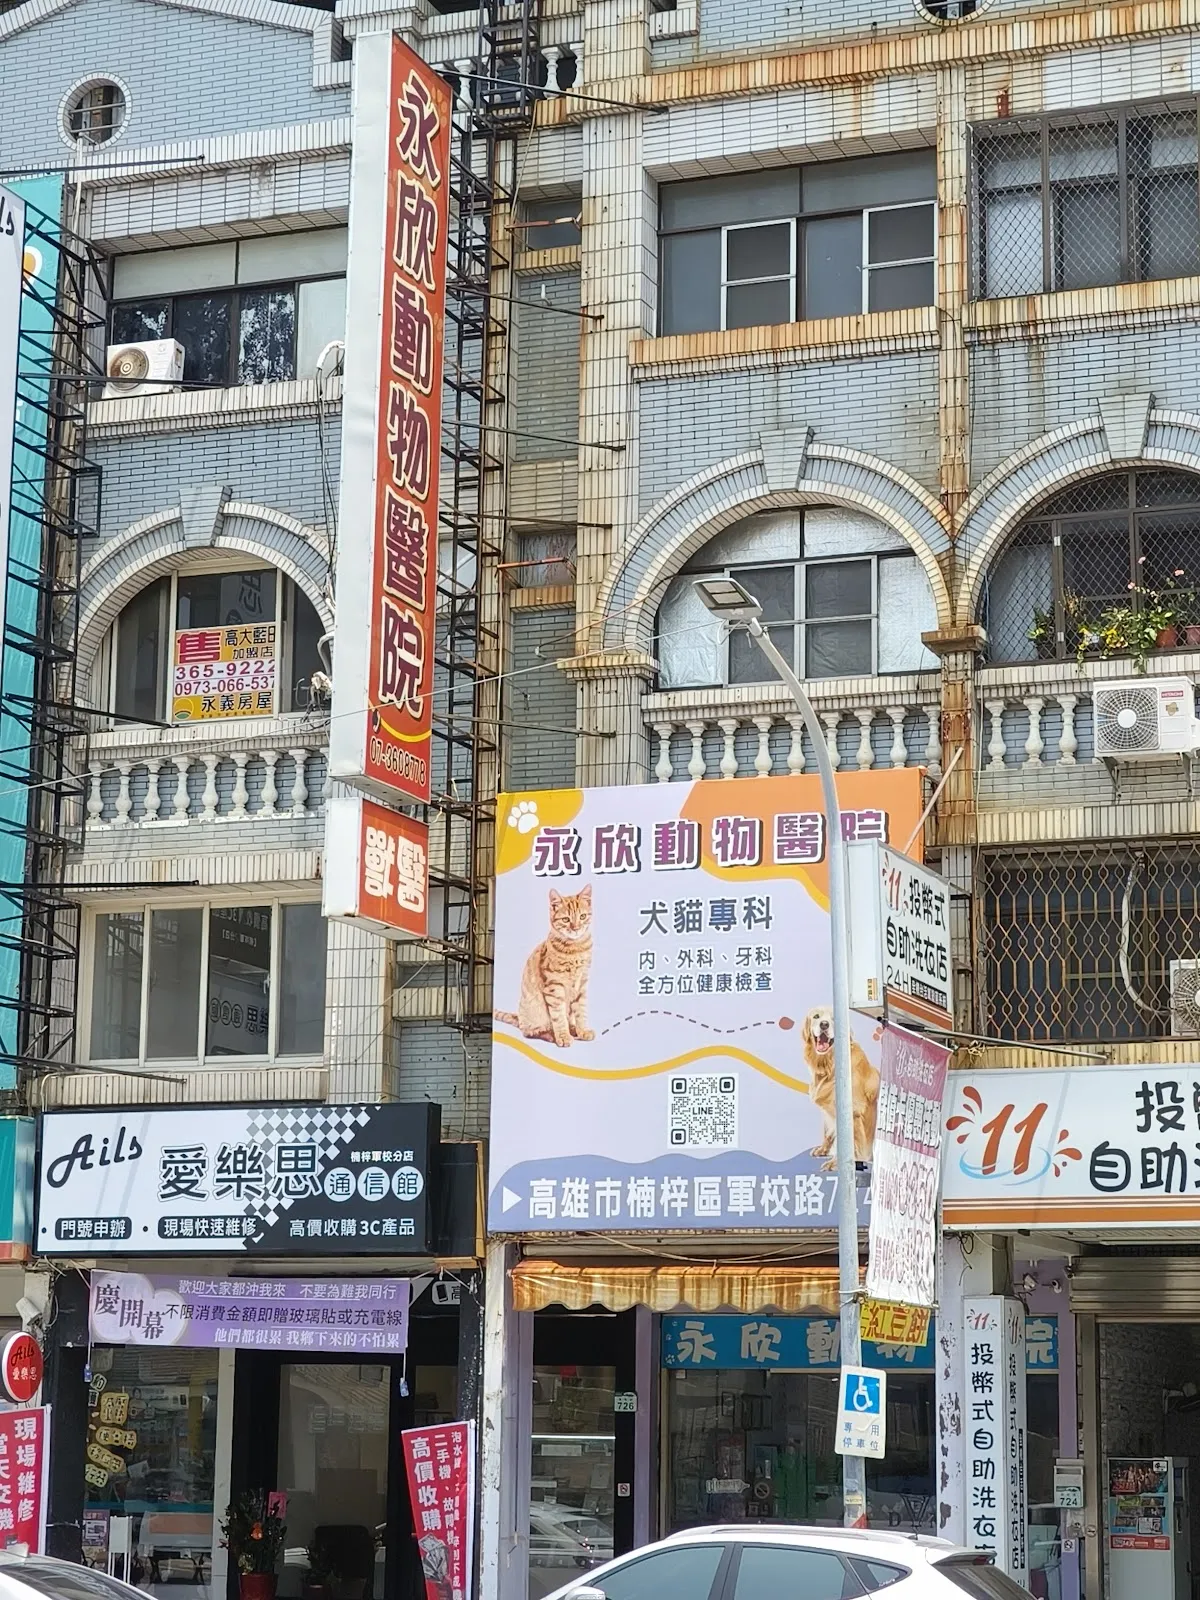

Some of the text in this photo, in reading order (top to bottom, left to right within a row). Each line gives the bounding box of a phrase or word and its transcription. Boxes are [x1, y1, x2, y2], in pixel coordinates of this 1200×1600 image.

[379, 68, 442, 721] 永欣動物醫院
[178, 631, 222, 664] 售
[232, 646, 274, 661] 加盟店
[176, 660, 276, 680] 365-9222
[201, 692, 273, 713] 永義房屋
[370, 735, 427, 787] 07-3608778
[533, 809, 890, 876] 永欣動物醫院
[639, 895, 774, 936] 犬貓專科
[909, 874, 947, 931] 投幣式
[886, 915, 948, 983] 自助洗衣店
[638, 971, 773, 996] 全方位健康檢查
[886, 964, 910, 995] 24H
[692, 1106, 714, 1115] LINE
[1135, 1080, 1200, 1133] 投
[980, 1103, 1049, 1177] 11
[46, 1126, 143, 1189] Ails
[350, 1150, 414, 1163] 楠梓軍校分店
[1088, 1140, 1200, 1194] 自助
[158, 1143, 324, 1203] 愛樂思
[326, 1169, 422, 1200] 通信館
[60, 1219, 126, 1238] 門號申辦
[163, 1218, 257, 1238] 現場快速維修
[178, 1280, 397, 1300] 歡迎大家都沖我來 不要為難我同行
[94, 1284, 165, 1339] 慶開幕
[162, 1303, 403, 1327] 不限消費金額即贈玻璃貼或充電線
[214, 1328, 400, 1348] 他們都很累 我鄉下來的不怕累
[10, 1344, 36, 1367] Ails
[12, 1368, 38, 1381] 愛樂思
[617, 1402, 634, 1411] 726
[842, 1436, 880, 1453] 停車位
[14, 1416, 38, 1523] 現場維修
[410, 1436, 442, 1532] 高價收購
[1059, 1497, 1078, 1506] 724
